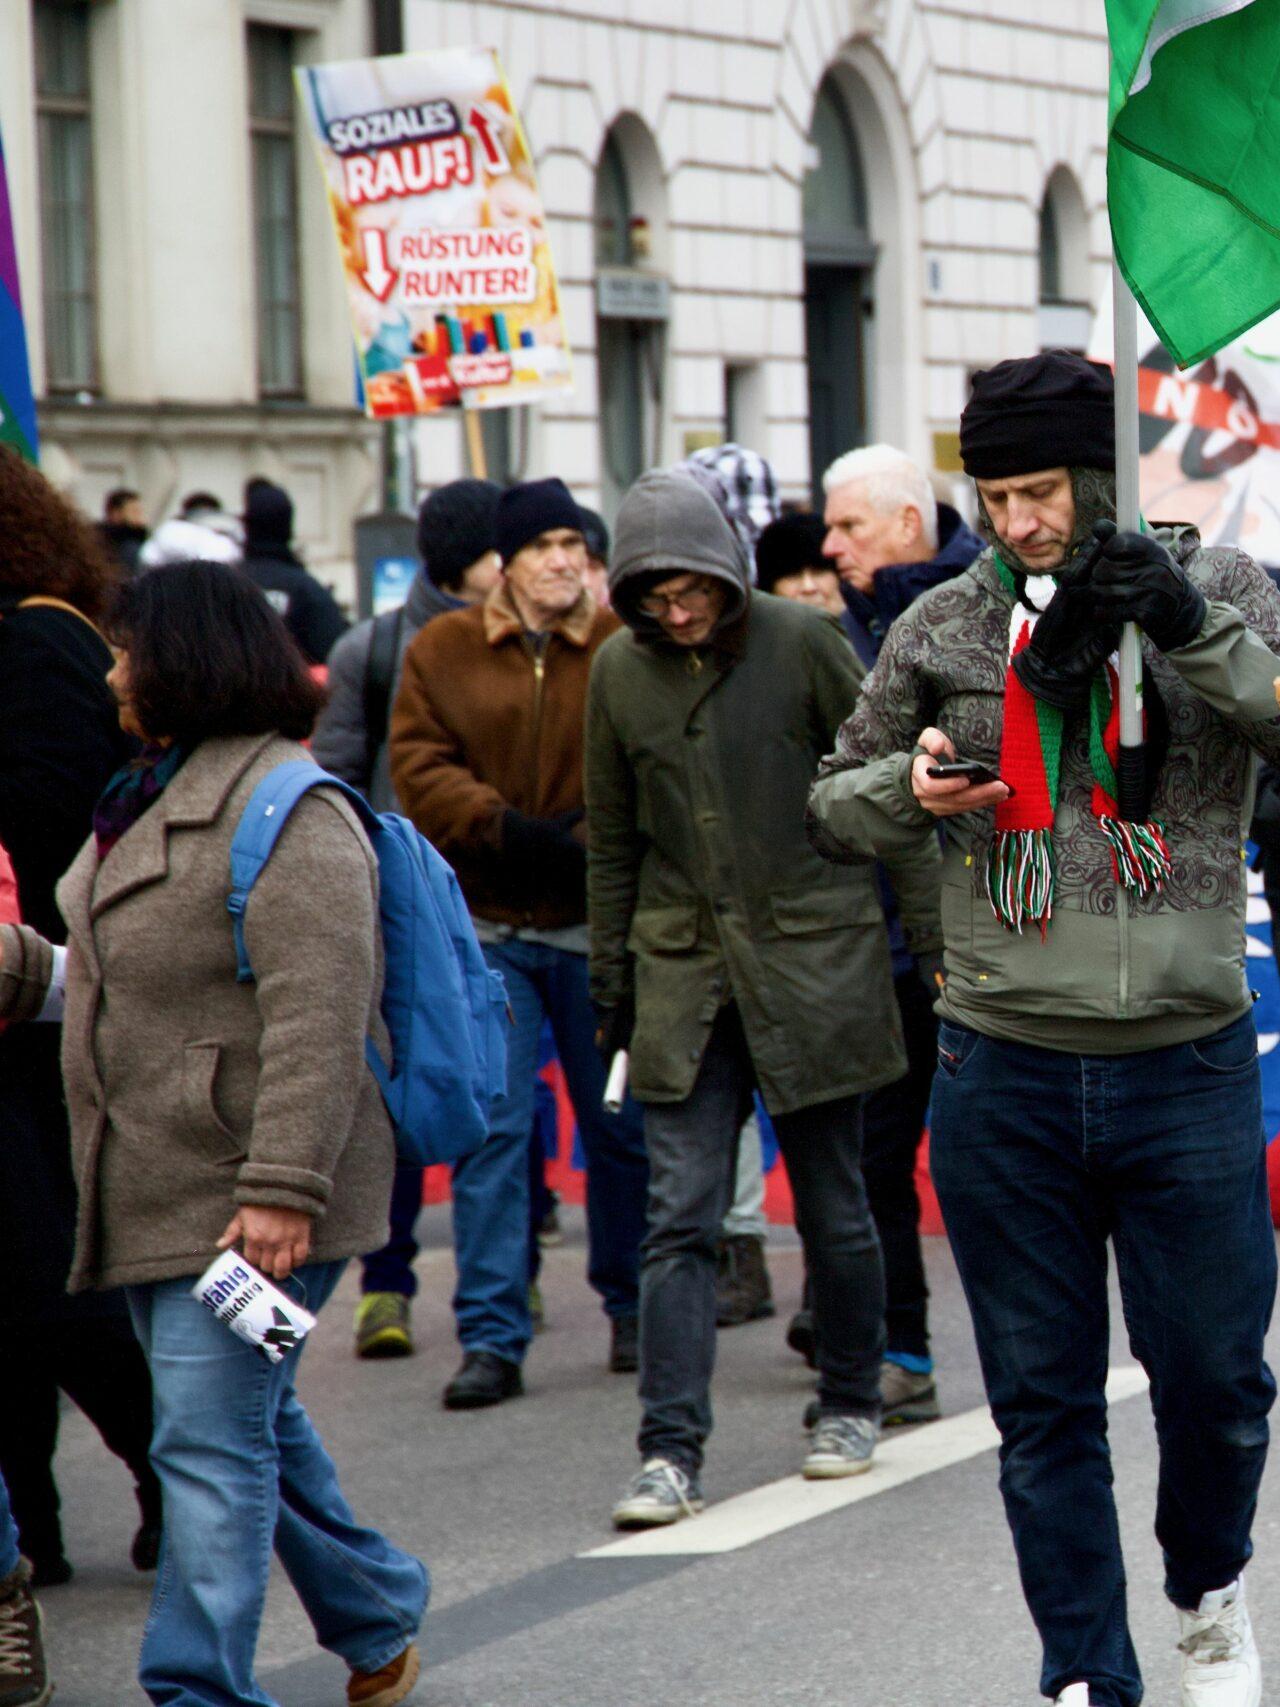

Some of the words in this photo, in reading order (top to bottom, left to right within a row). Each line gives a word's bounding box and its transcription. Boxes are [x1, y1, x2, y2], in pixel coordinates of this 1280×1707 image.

[330, 106, 455, 150] SOZIALES
[347, 139, 471, 201] RAUF!
[400, 229, 524, 259] RÜSTUNG
[404, 267, 530, 298] RUNTER!
